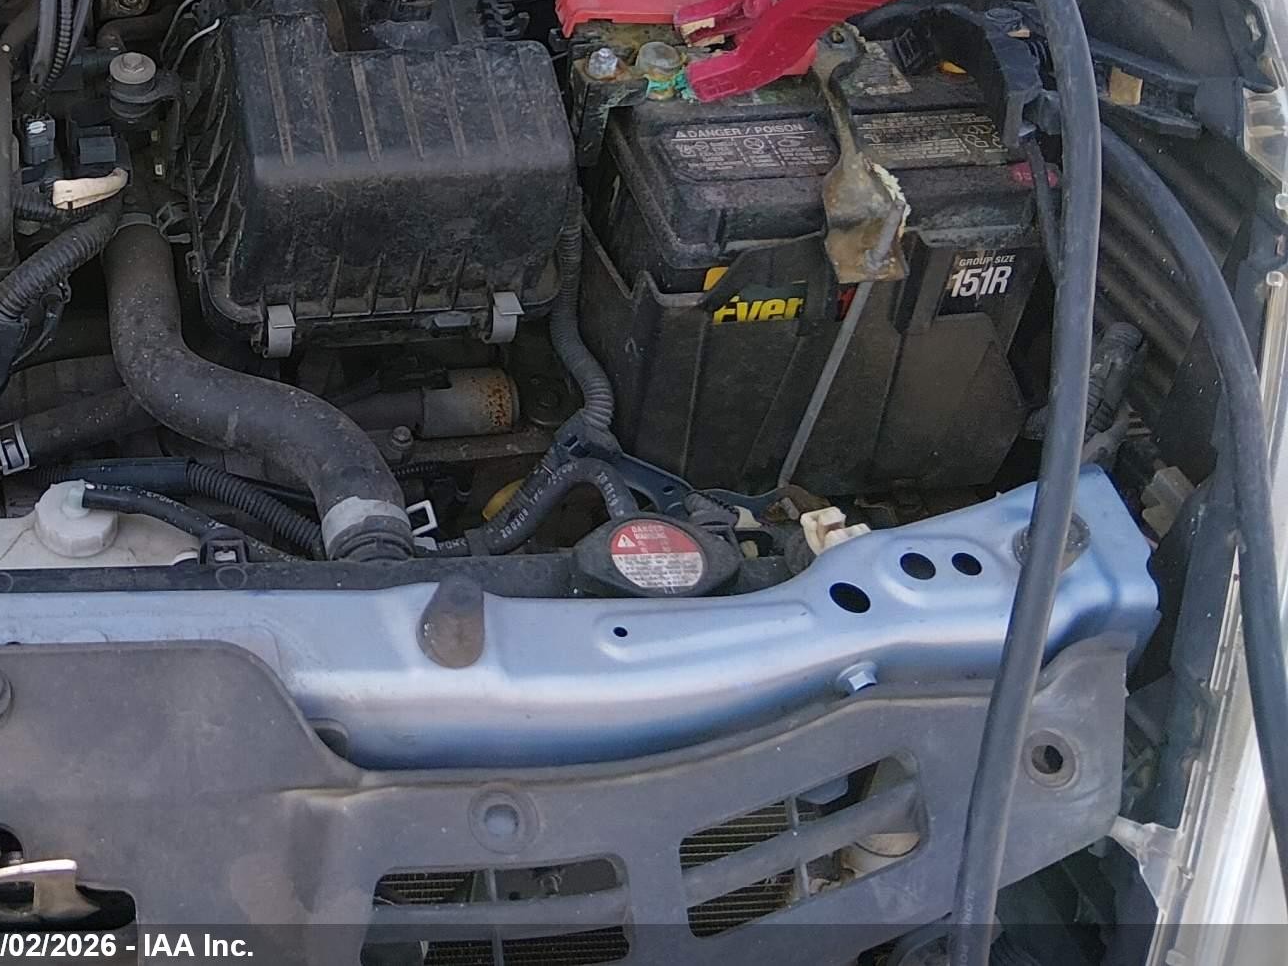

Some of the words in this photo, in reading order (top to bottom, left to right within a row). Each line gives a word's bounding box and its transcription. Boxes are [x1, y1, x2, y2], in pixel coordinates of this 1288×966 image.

[686, 127, 742, 139] DANGER
[754, 123, 804, 134] POISON
[959, 257, 993, 267] GROUP
[994, 254, 1017, 264] SIZE
[951, 265, 1012, 298] 151R
